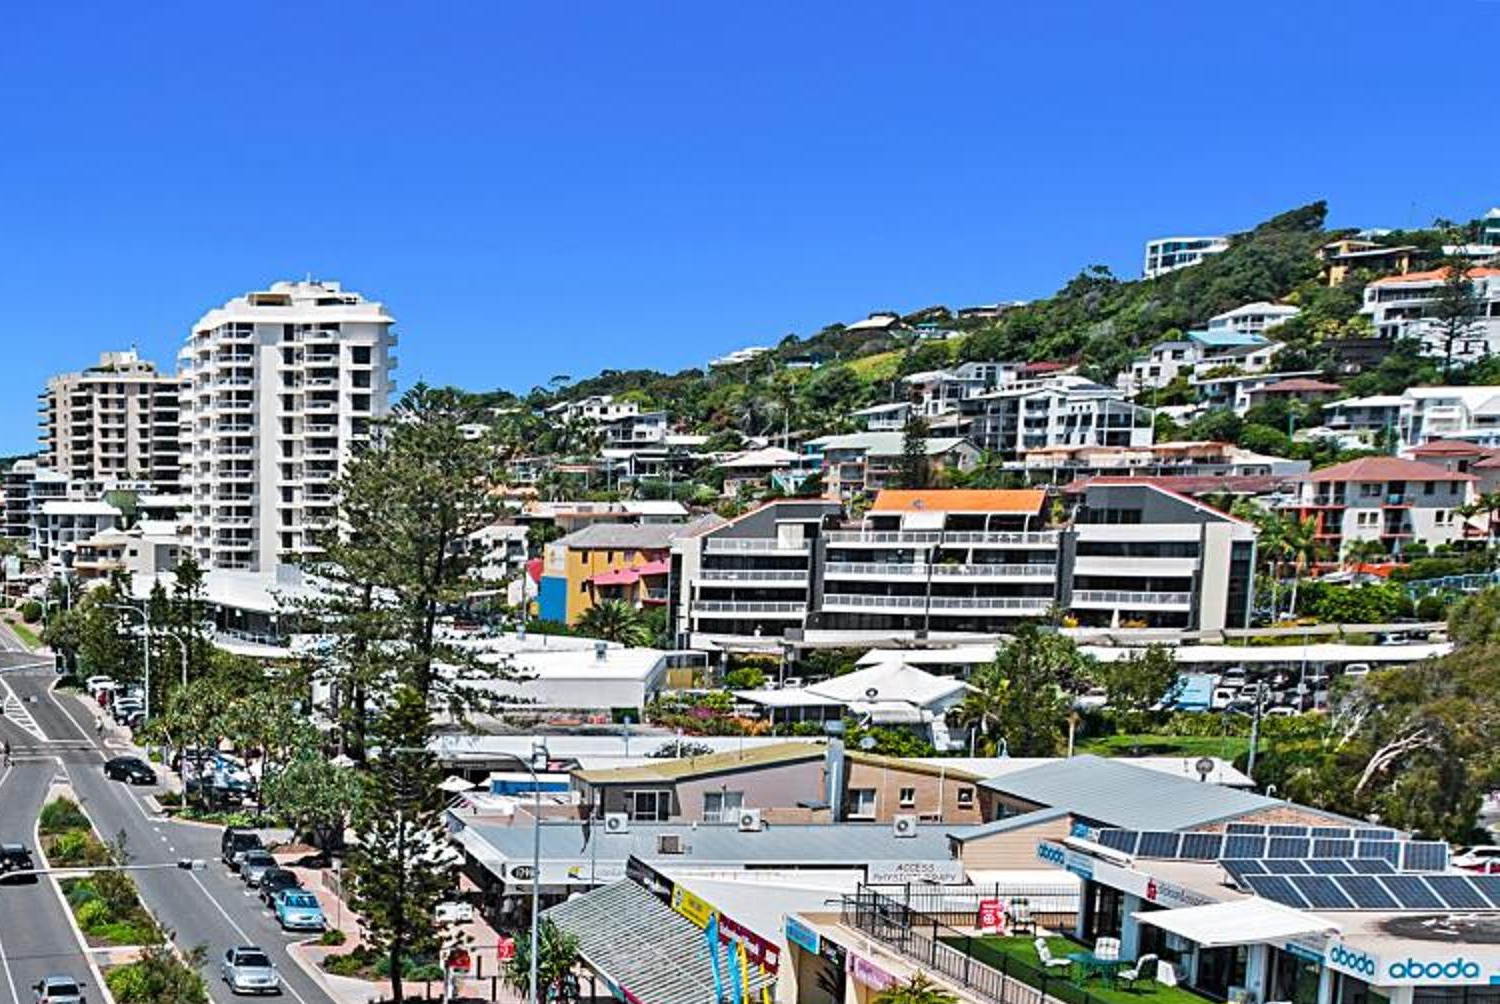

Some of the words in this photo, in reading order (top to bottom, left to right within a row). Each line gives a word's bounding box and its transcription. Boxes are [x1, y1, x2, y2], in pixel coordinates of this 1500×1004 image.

[895, 863, 935, 873] ACCESS
[1331, 944, 1376, 976] aboda
[1389, 957, 1480, 979] aboda
